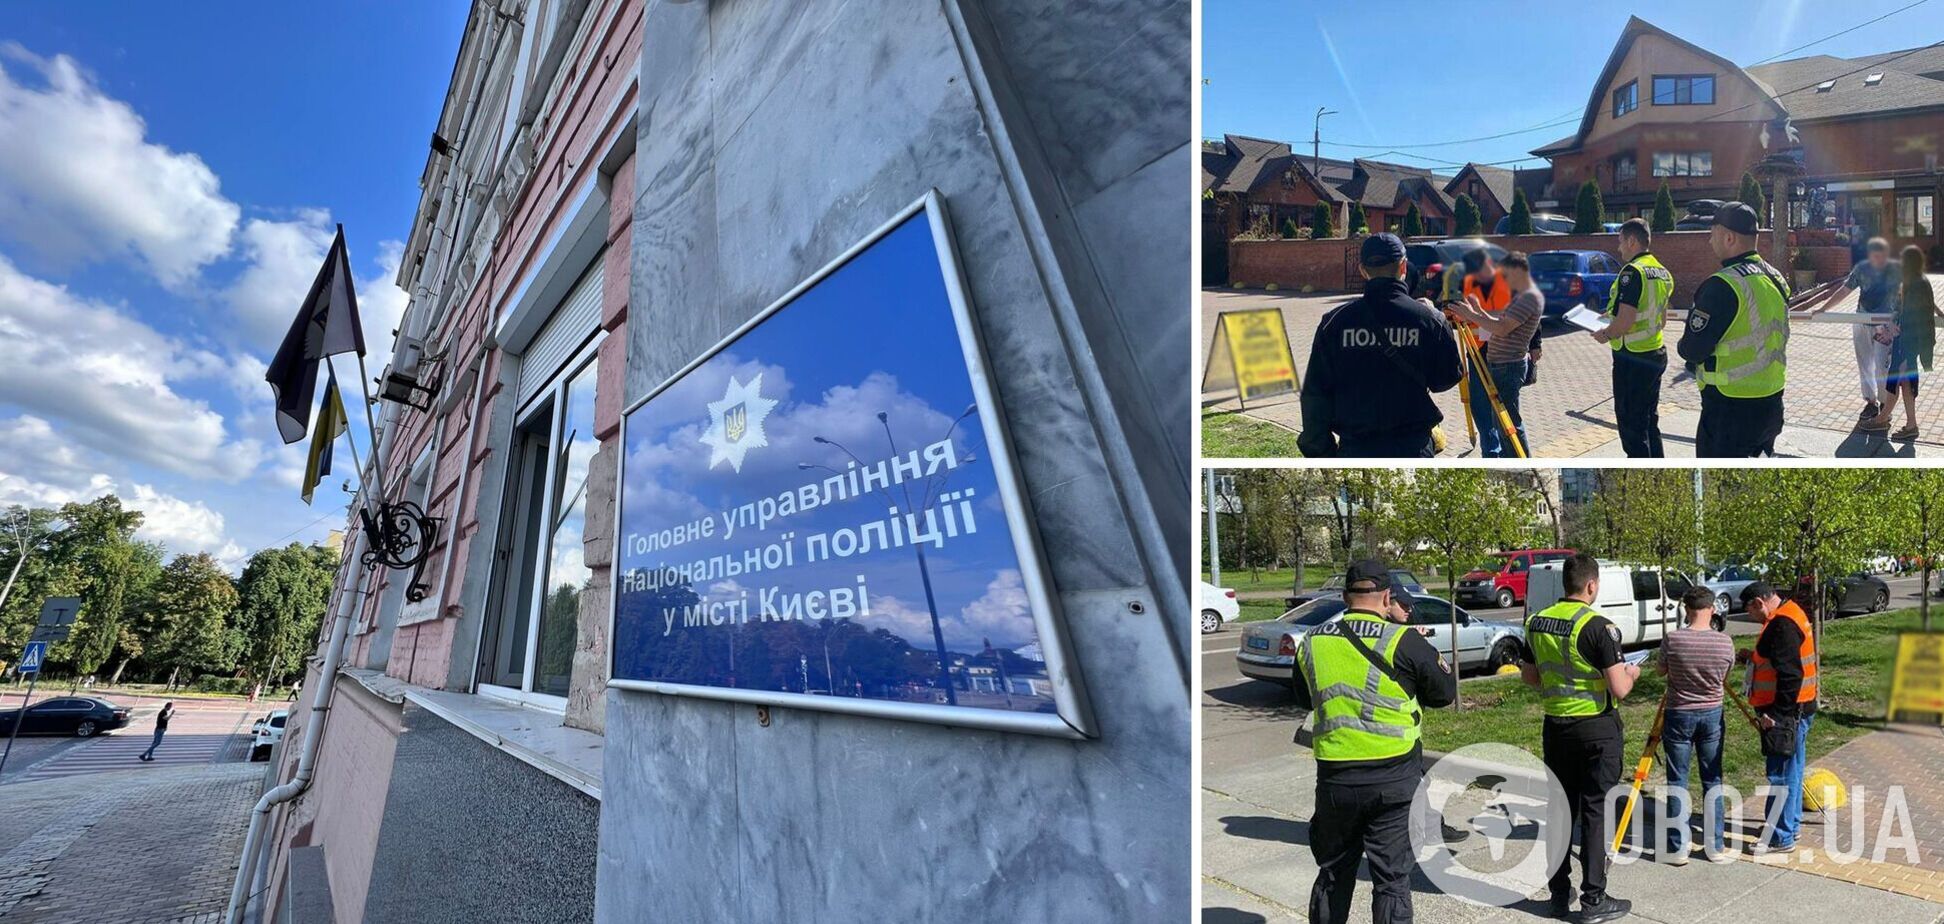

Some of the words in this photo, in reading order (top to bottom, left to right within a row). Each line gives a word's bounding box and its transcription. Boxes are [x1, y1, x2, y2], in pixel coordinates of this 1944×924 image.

[1343, 327, 1419, 347] ПОЦІЯ
[627, 516, 715, 557] Головне
[722, 438, 958, 540] управління
[623, 532, 795, 594] Національної
[806, 488, 977, 563] поліції
[663, 605, 676, 637] у
[683, 590, 749, 628] місті
[759, 574, 870, 624] Києві
[1310, 620, 1383, 638] ПОЦІЯ
